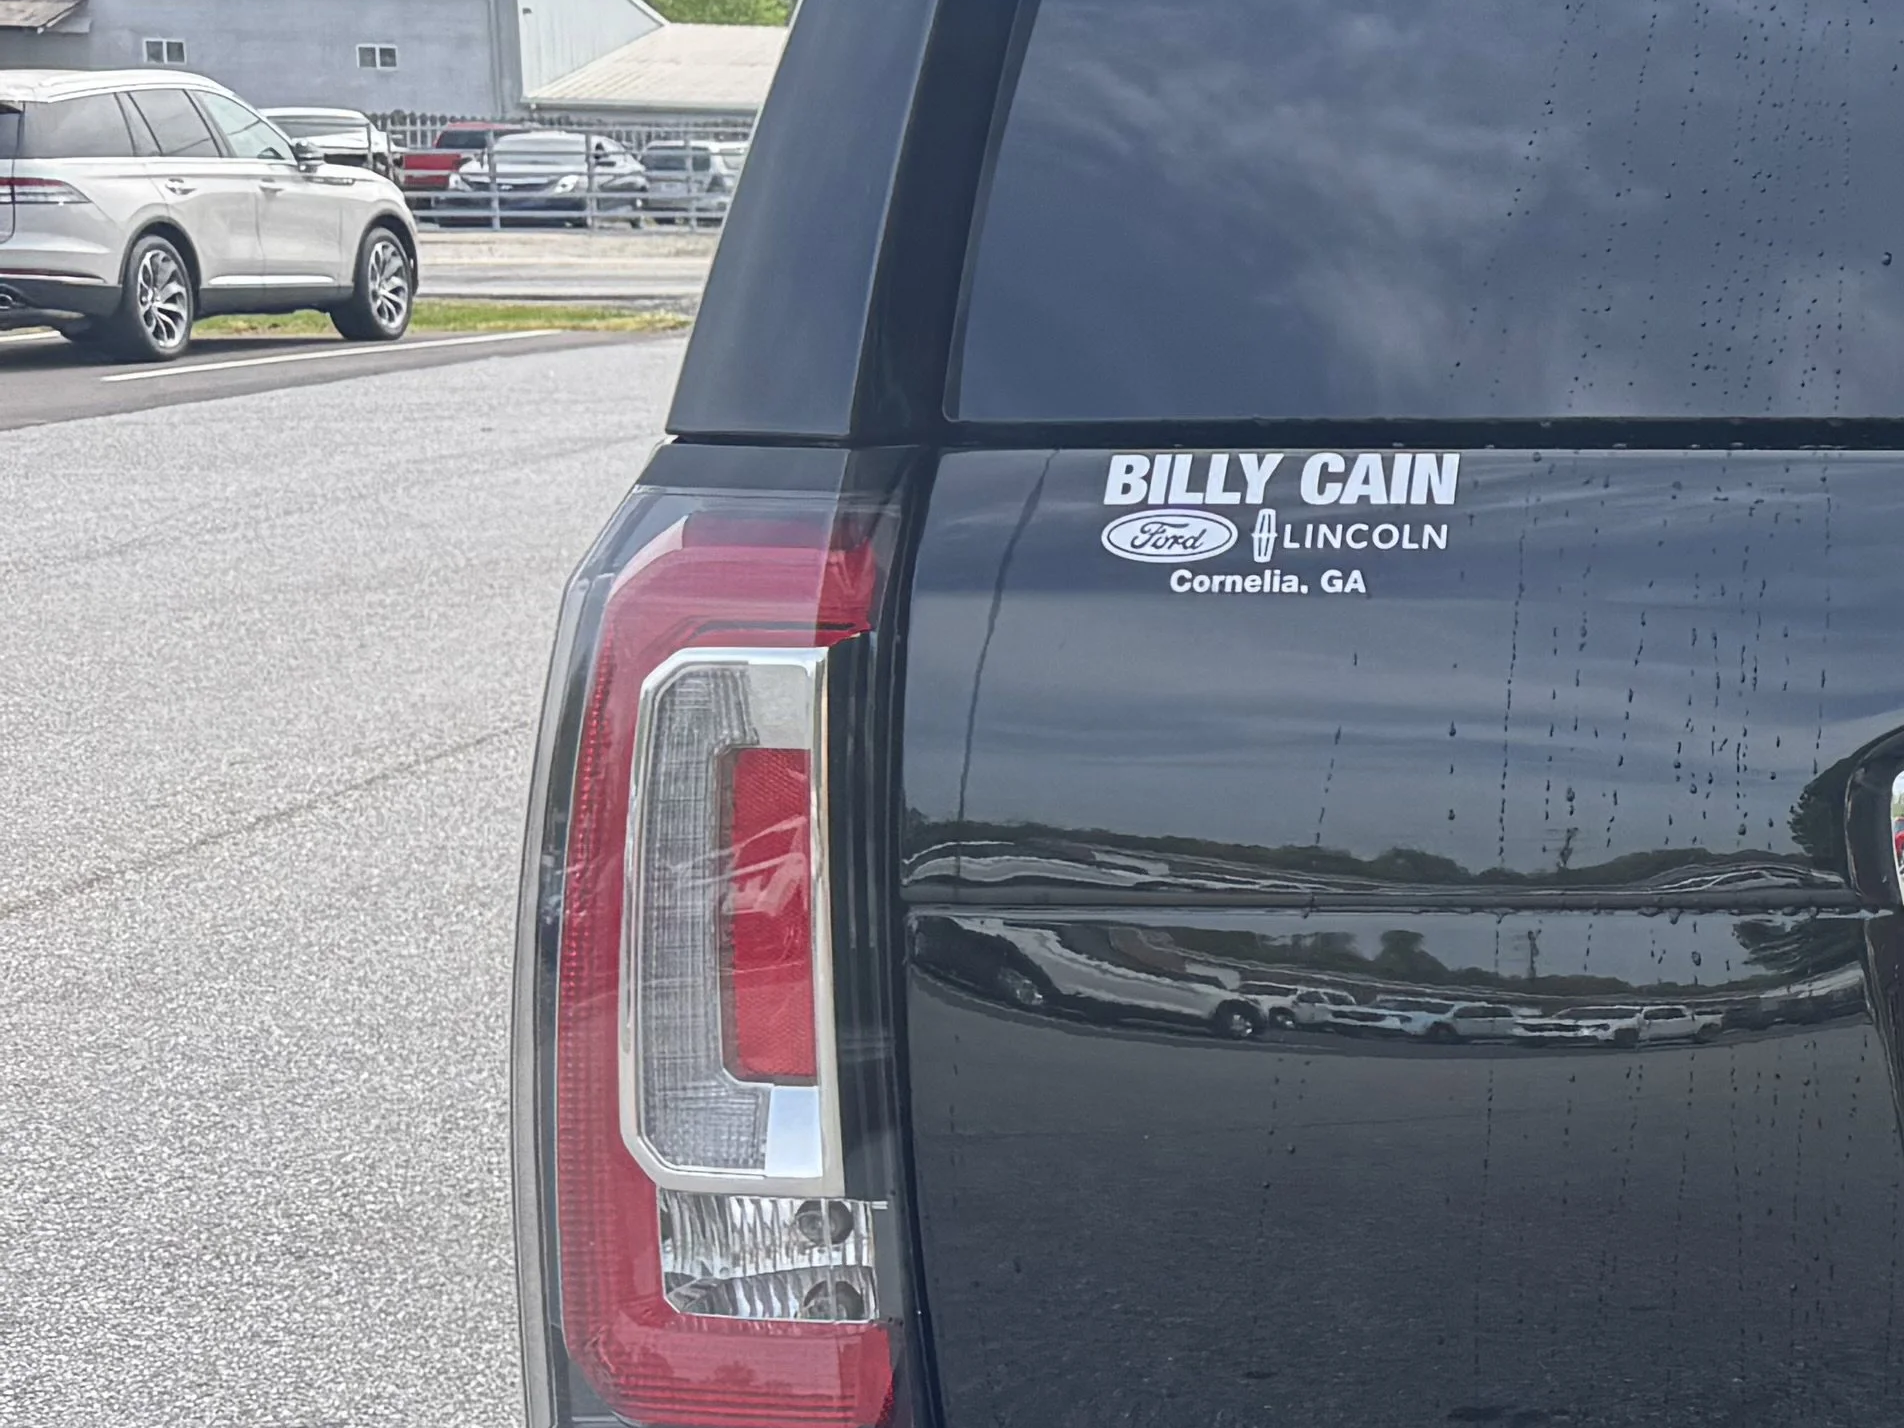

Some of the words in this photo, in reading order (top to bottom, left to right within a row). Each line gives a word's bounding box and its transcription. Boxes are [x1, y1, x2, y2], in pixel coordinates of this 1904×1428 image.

[1103, 453, 1285, 505] BILLY
[1300, 452, 1461, 505] CAIN
[1130, 521, 1206, 551] Ford
[1283, 523, 1449, 550] LINCOLN
[1170, 569, 1309, 594] Cornelia,
[1320, 569, 1367, 594] GA
